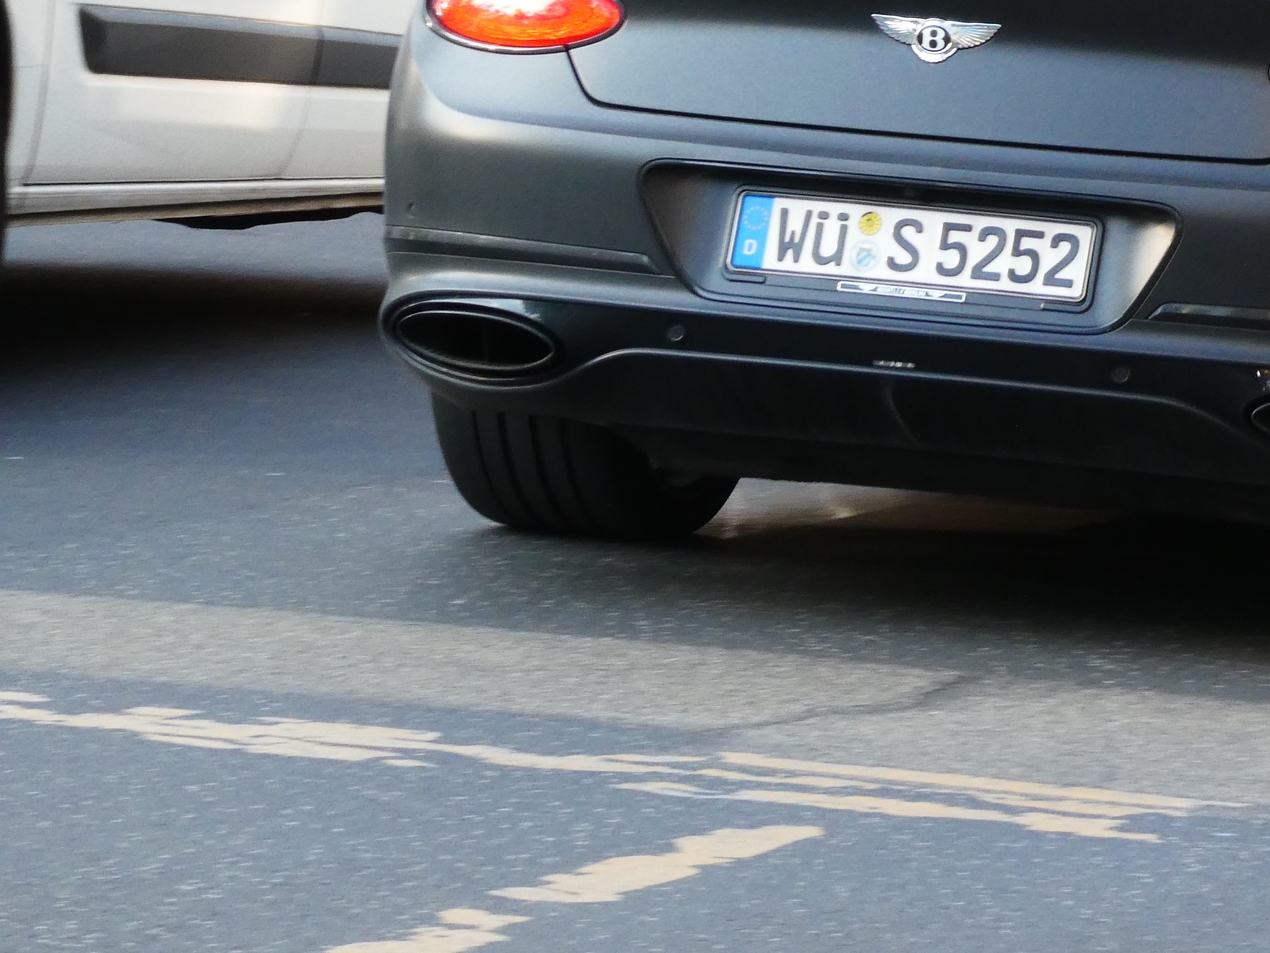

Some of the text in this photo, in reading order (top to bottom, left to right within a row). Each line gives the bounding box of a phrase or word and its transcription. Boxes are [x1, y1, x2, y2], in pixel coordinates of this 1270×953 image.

[921, 29, 946, 51] B
[742, 207, 1081, 289] D WÜ S 5252
